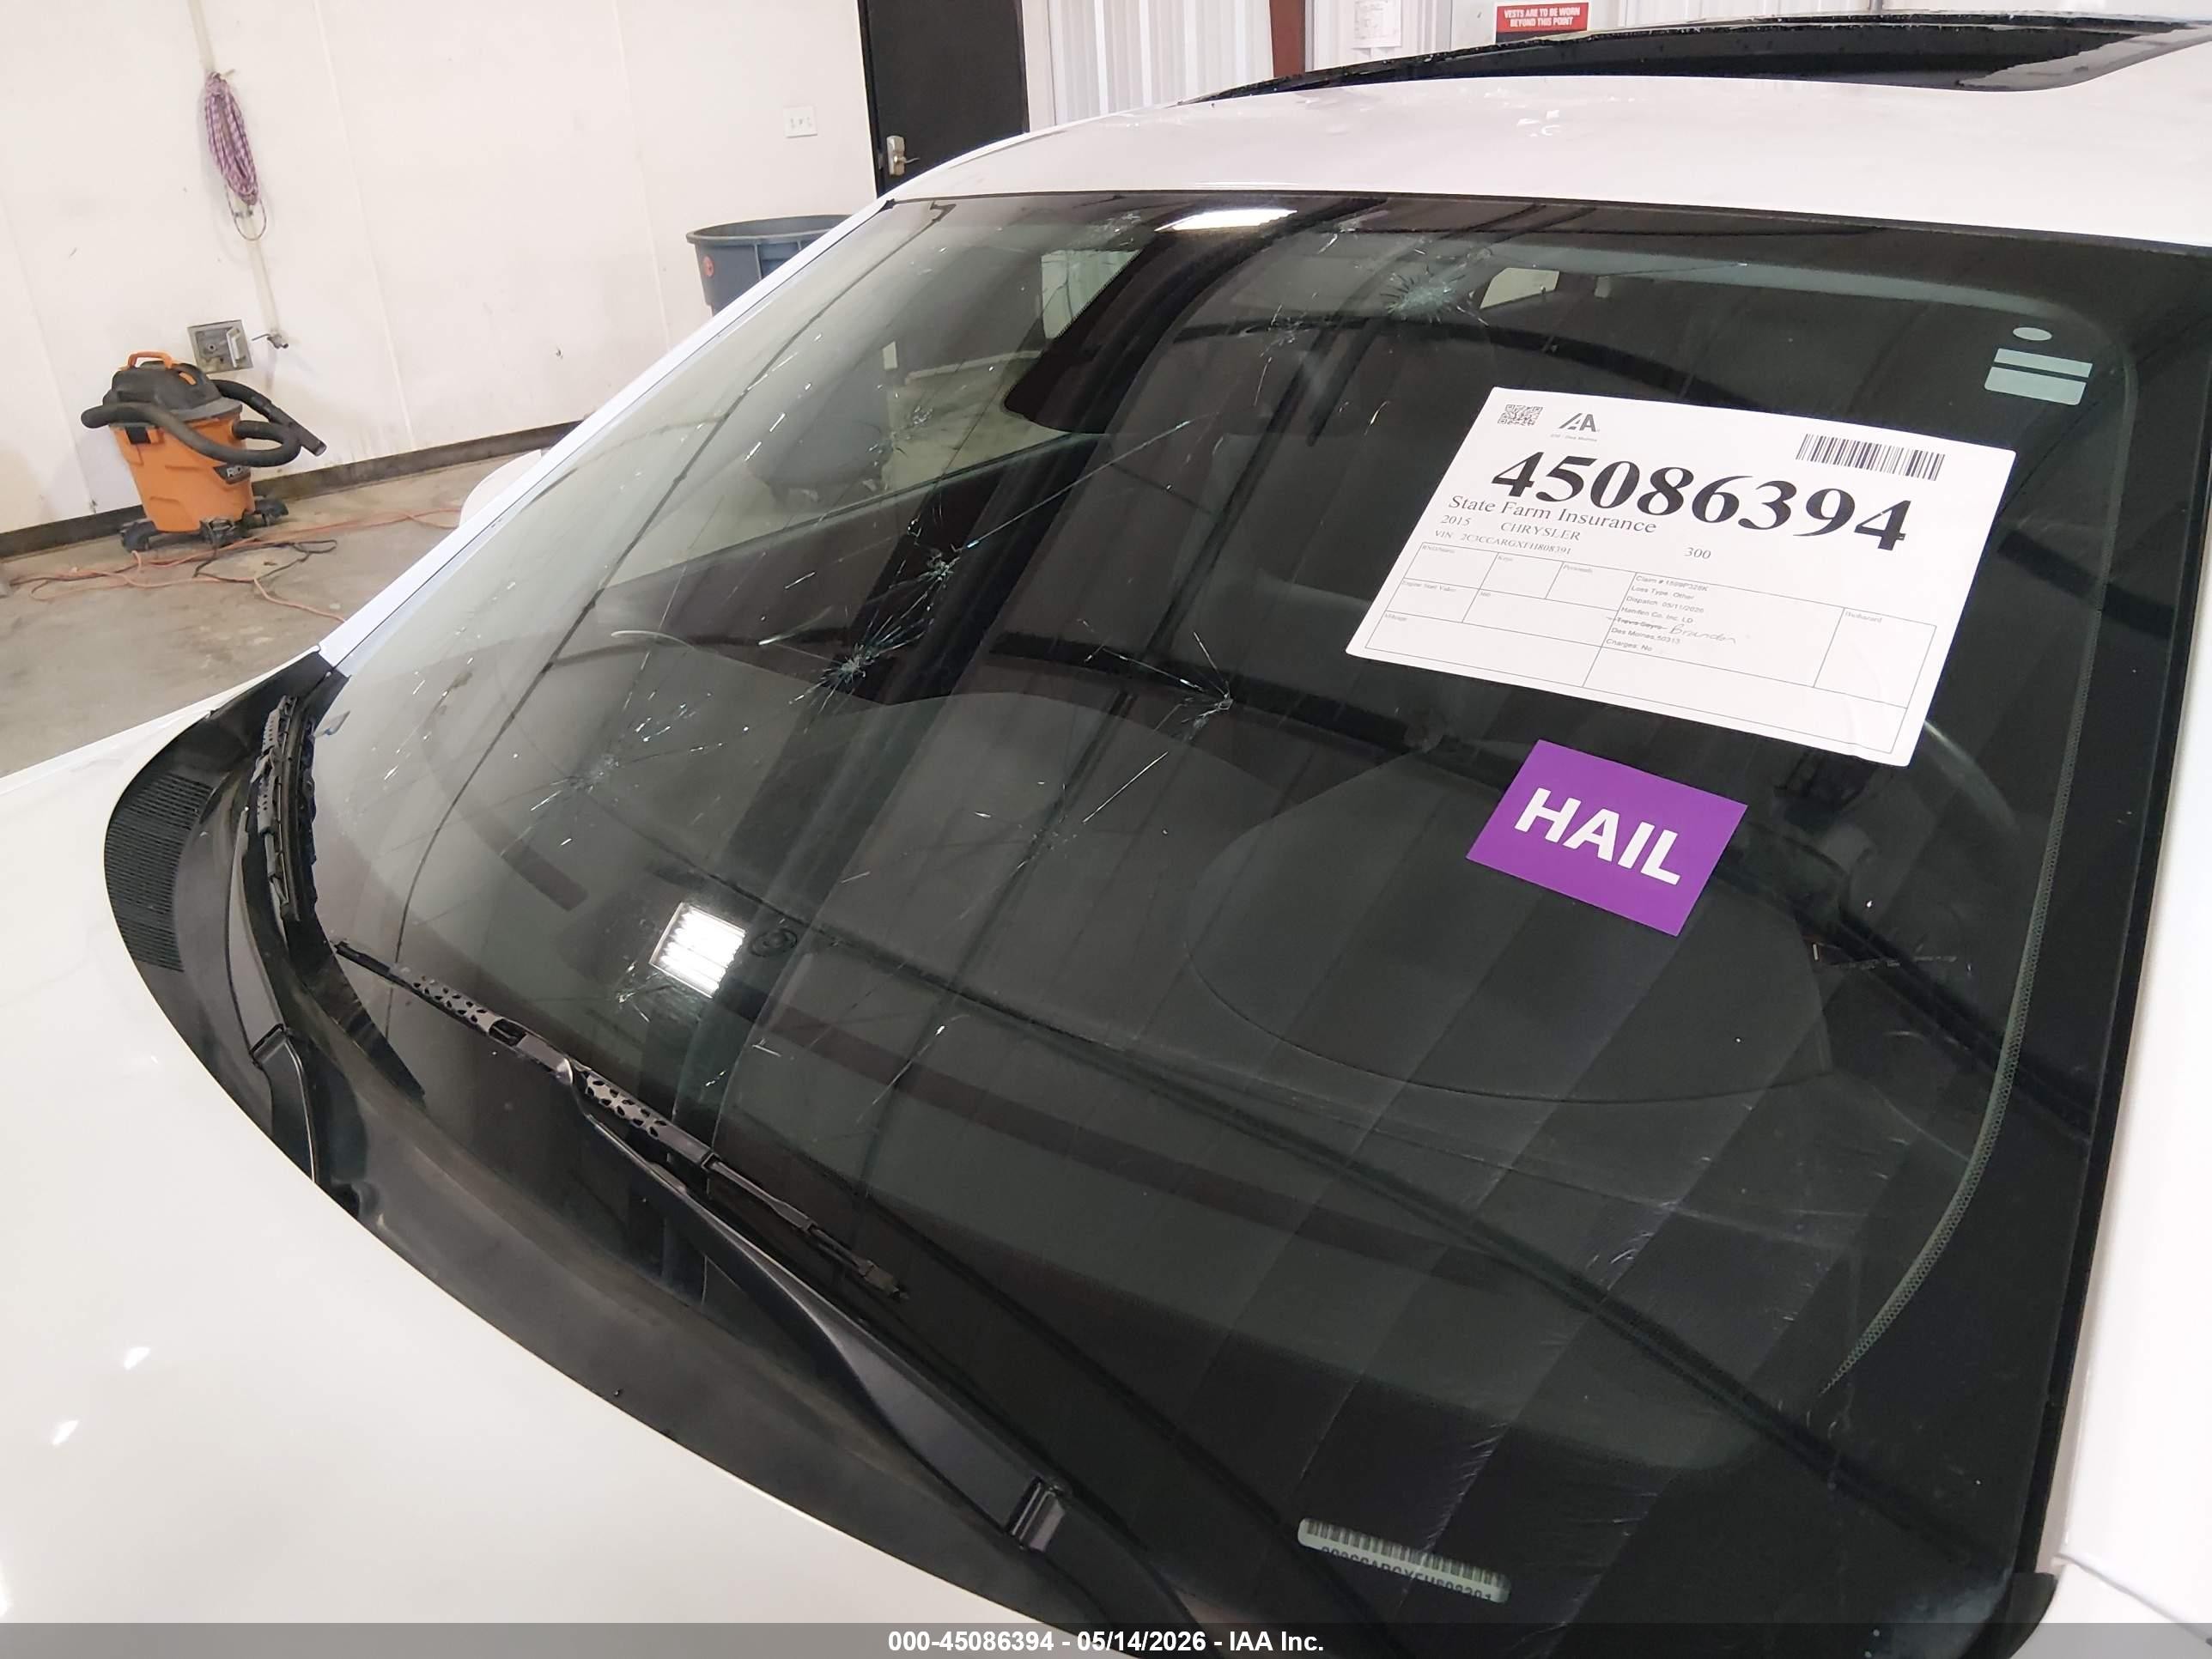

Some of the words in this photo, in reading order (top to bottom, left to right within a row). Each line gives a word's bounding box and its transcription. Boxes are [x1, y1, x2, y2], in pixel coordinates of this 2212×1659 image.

[1504, 9, 1525, 18] VESTS
[1525, 9, 1538, 17] ARE
[1540, 9, 1548, 17] TO
[1549, 8, 1558, 16] BE
[1559, 7, 1580, 16] WORN
[1510, 18, 1536, 27] BEYOND
[1537, 17, 1552, 27] THIS
[1553, 16, 1573, 26] POINT
[1449, 495, 1496, 513] State
[1501, 501, 1552, 520] Farm
[1557, 507, 1657, 533] Insurance
[1492, 451, 1911, 550] 45086394
[1440, 514, 1472, 526] 2015
[1500, 522, 1582, 542] CHRYSLER
[1684, 546, 1712, 560] 300
[1514, 787, 1680, 885] HAIL
